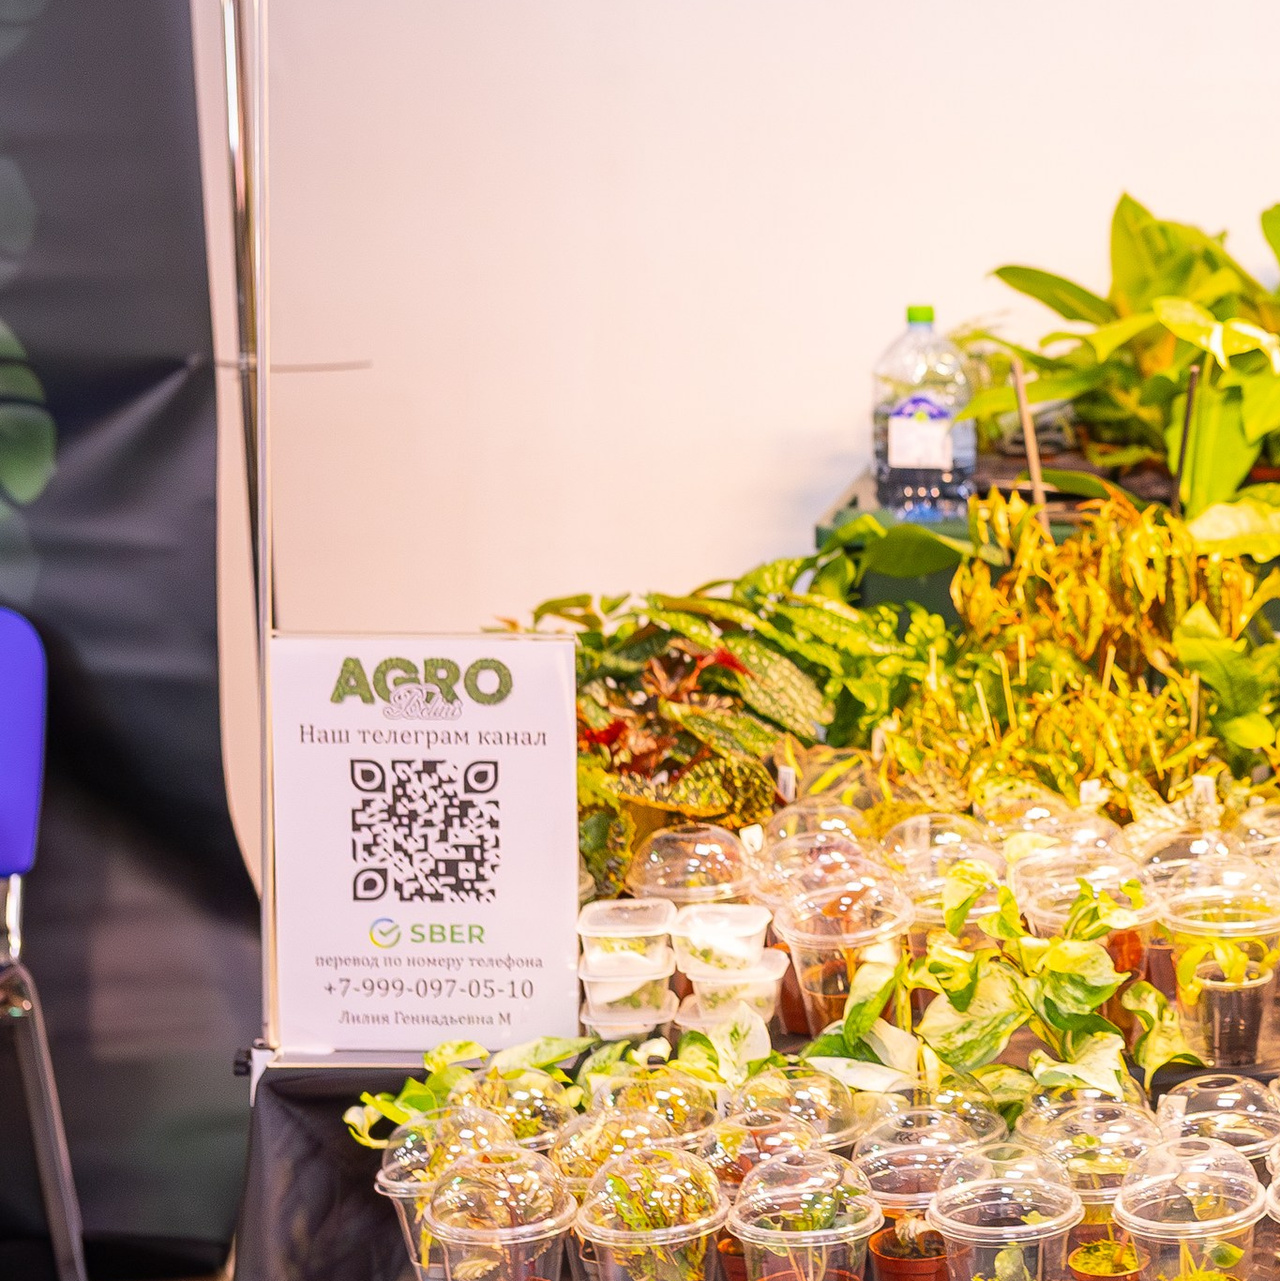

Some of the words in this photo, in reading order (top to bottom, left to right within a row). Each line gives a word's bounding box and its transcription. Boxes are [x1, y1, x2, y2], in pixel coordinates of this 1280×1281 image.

[330, 656, 513, 706] AGRO
[299, 724, 350, 745] Наш
[357, 727, 470, 750] телеграм
[478, 728, 548, 747] канал
[410, 923, 485, 944] SBER
[315, 955, 379, 969] перевод
[383, 957, 402, 968] по
[407, 957, 464, 971] номеру
[469, 952, 544, 971] телефона
[324, 977, 534, 999] +7-999-097-05-10
[338, 1010, 390, 1026] Лилия
[395, 1011, 494, 1027] Геннадьевна
